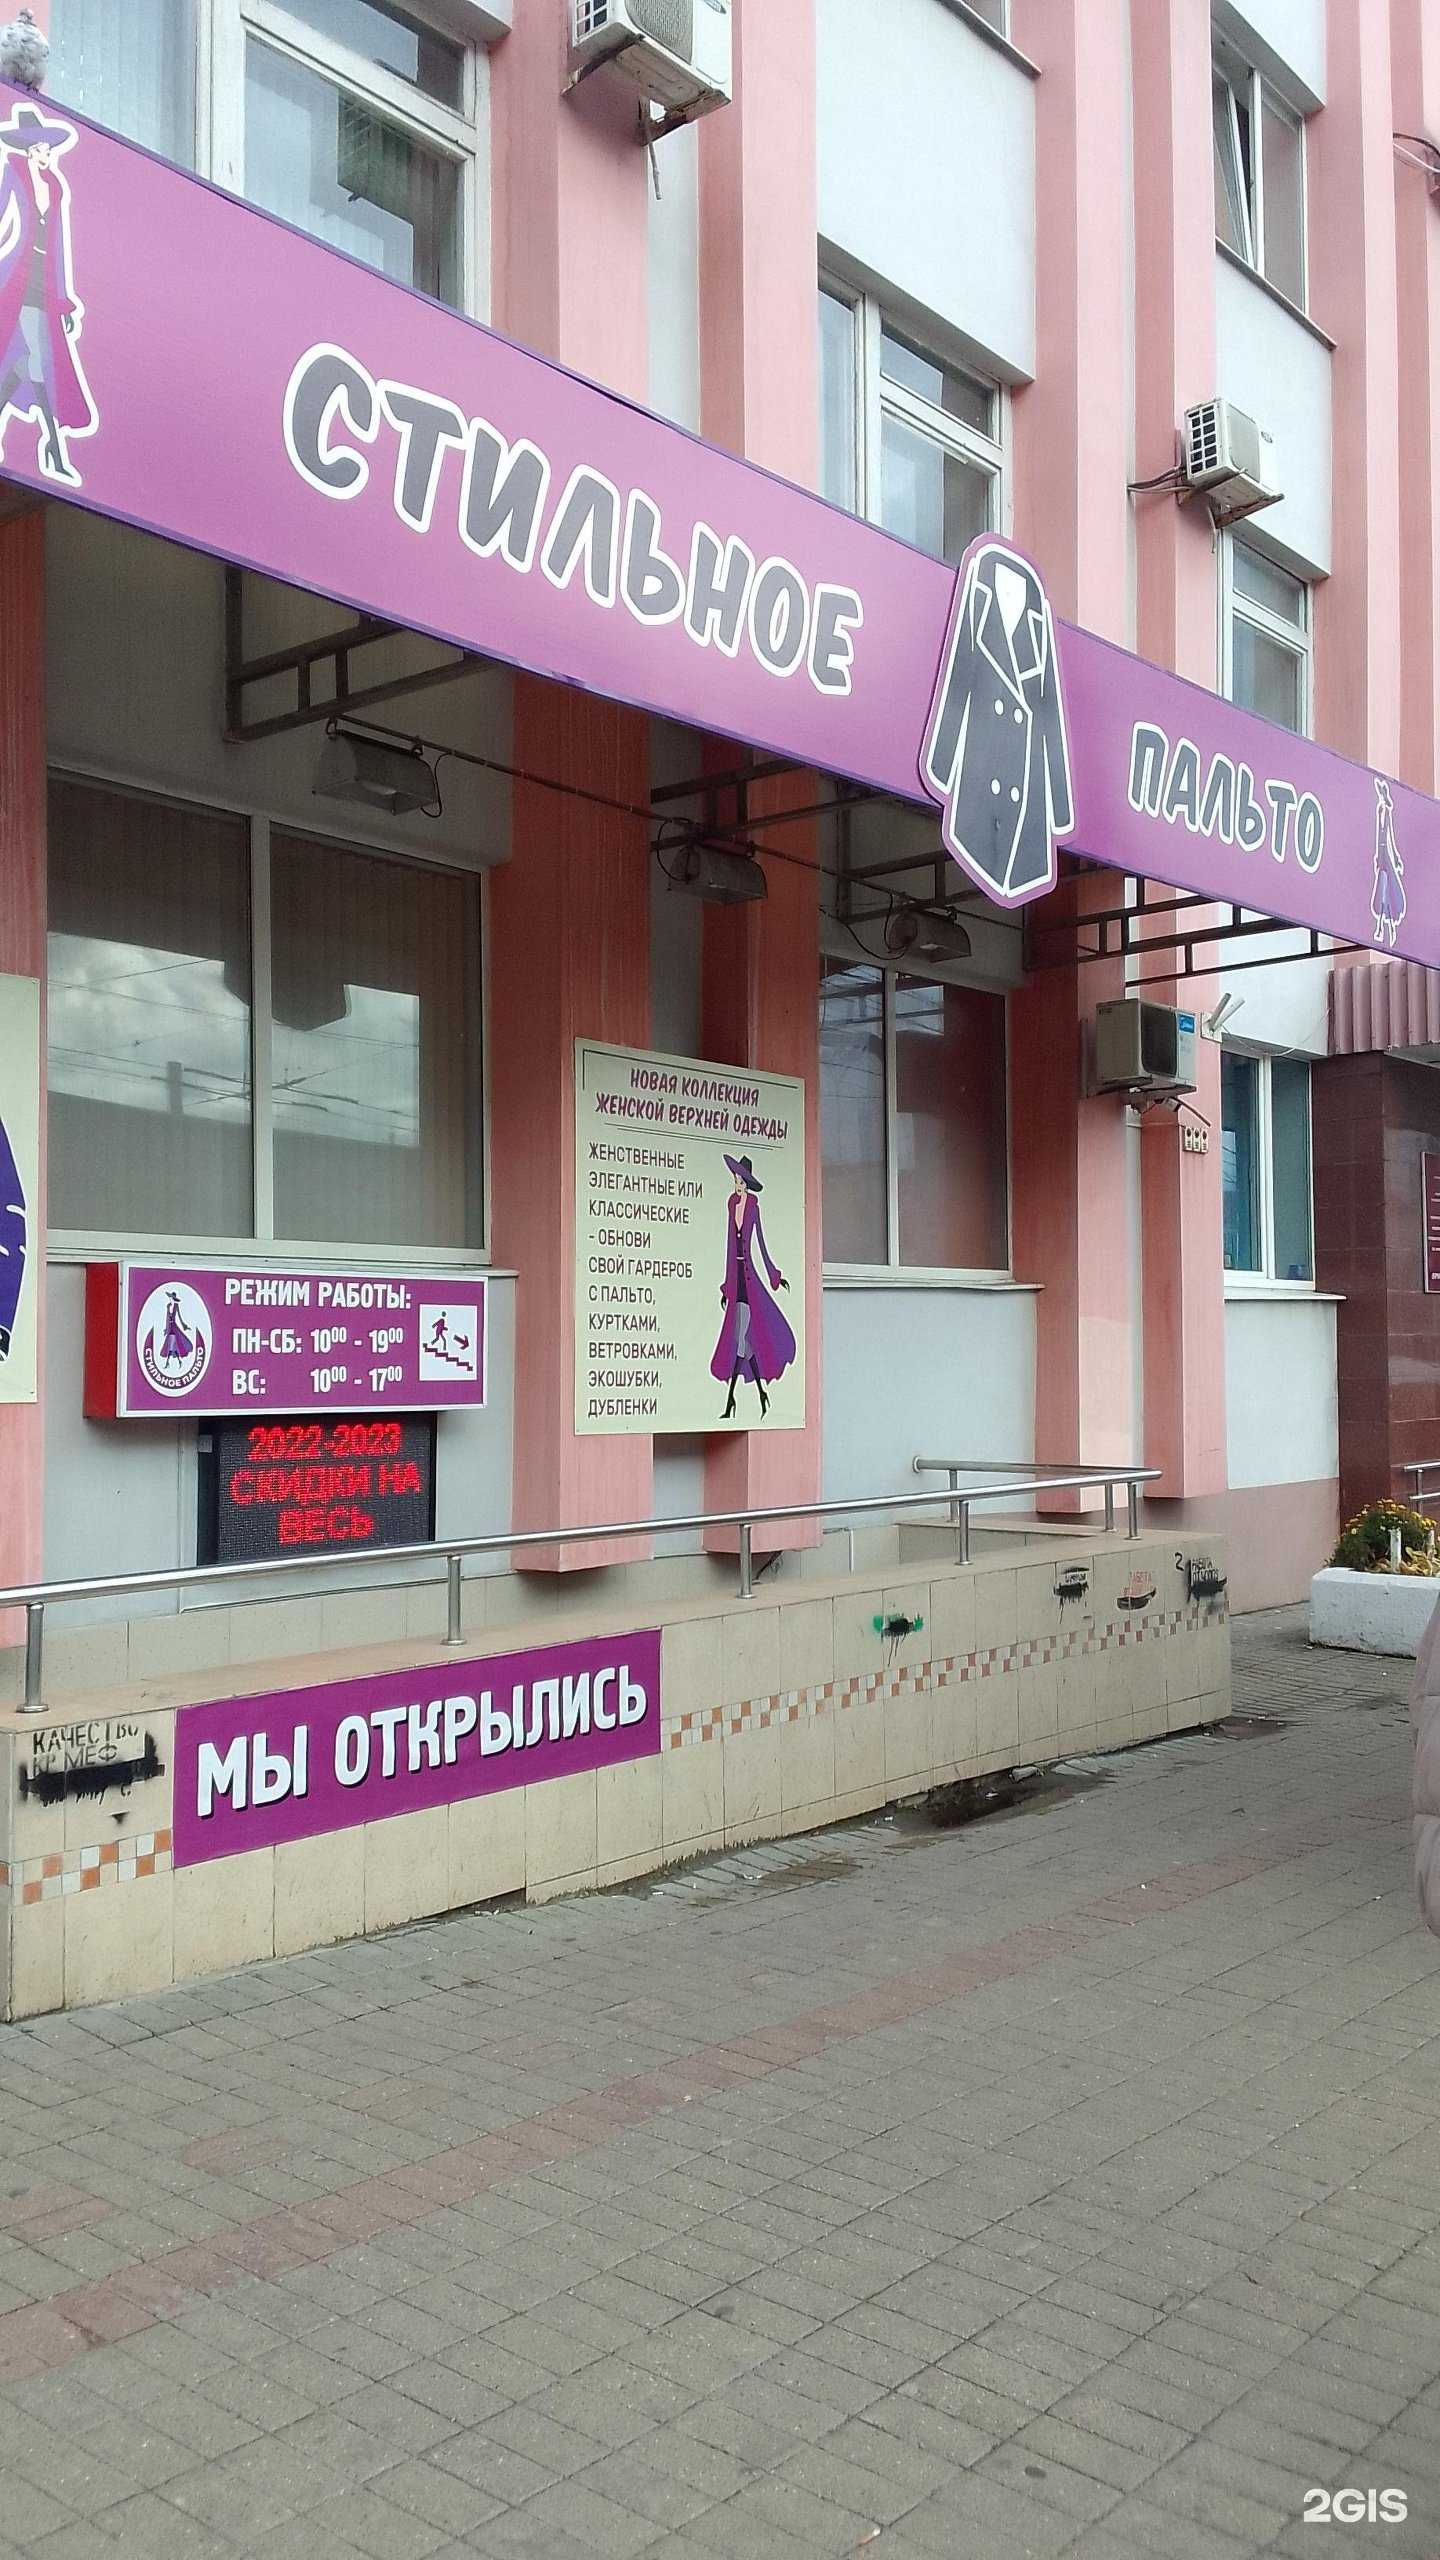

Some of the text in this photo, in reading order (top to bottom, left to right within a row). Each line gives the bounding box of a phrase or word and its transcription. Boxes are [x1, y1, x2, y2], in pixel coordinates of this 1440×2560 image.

[283, 342, 1324, 874] СТИЛЬНОЕ ПАЛЬТО
[630, 1067, 760, 1107] НОВАЯ КОЛЛЕКЦИЯ
[595, 1092, 788, 1140] ЖЕНСКОЙ ВЕРХНЕЙ ОДЕЖДЫ
[588, 1142, 685, 1170] ЖЕНСТВЕННЫЕ
[588, 1171, 703, 1199] ЭЛЕГАНТНЫЕ ИЛИ
[589, 1199, 690, 1224] КЛАССИЧЕСКИЕ
[598, 1228, 651, 1249] ОБНОВИ
[588, 1254, 693, 1279] СВОЙ ГАРДЕРОБ
[225, 1278, 411, 1309] РЕЖИМ РАБОТЫ:
[588, 1285, 656, 1305] С ПАЛЬТО,
[588, 1313, 660, 1333] КУРТКАМИ,
[232, 1328, 302, 1354] ПН-СБ:
[589, 1342, 678, 1361] ВЕТРОВКАМИ,
[145, 1347, 204, 1387] СТИЛЬНОЕ ПАЛЬТО
[588, 1370, 662, 1389] ЭКОШУБКИ,
[232, 1369, 266, 1395] ВС:
[588, 1399, 658, 1418] ДУБЛЕНКИ
[247, 1423, 402, 1461] 2022-2023
[377, 1460, 422, 1495] НА
[278, 1505, 374, 1545] ВЕСЬ
[197, 1664, 647, 1817] МЫ ОТКРЫЛИСЬ
